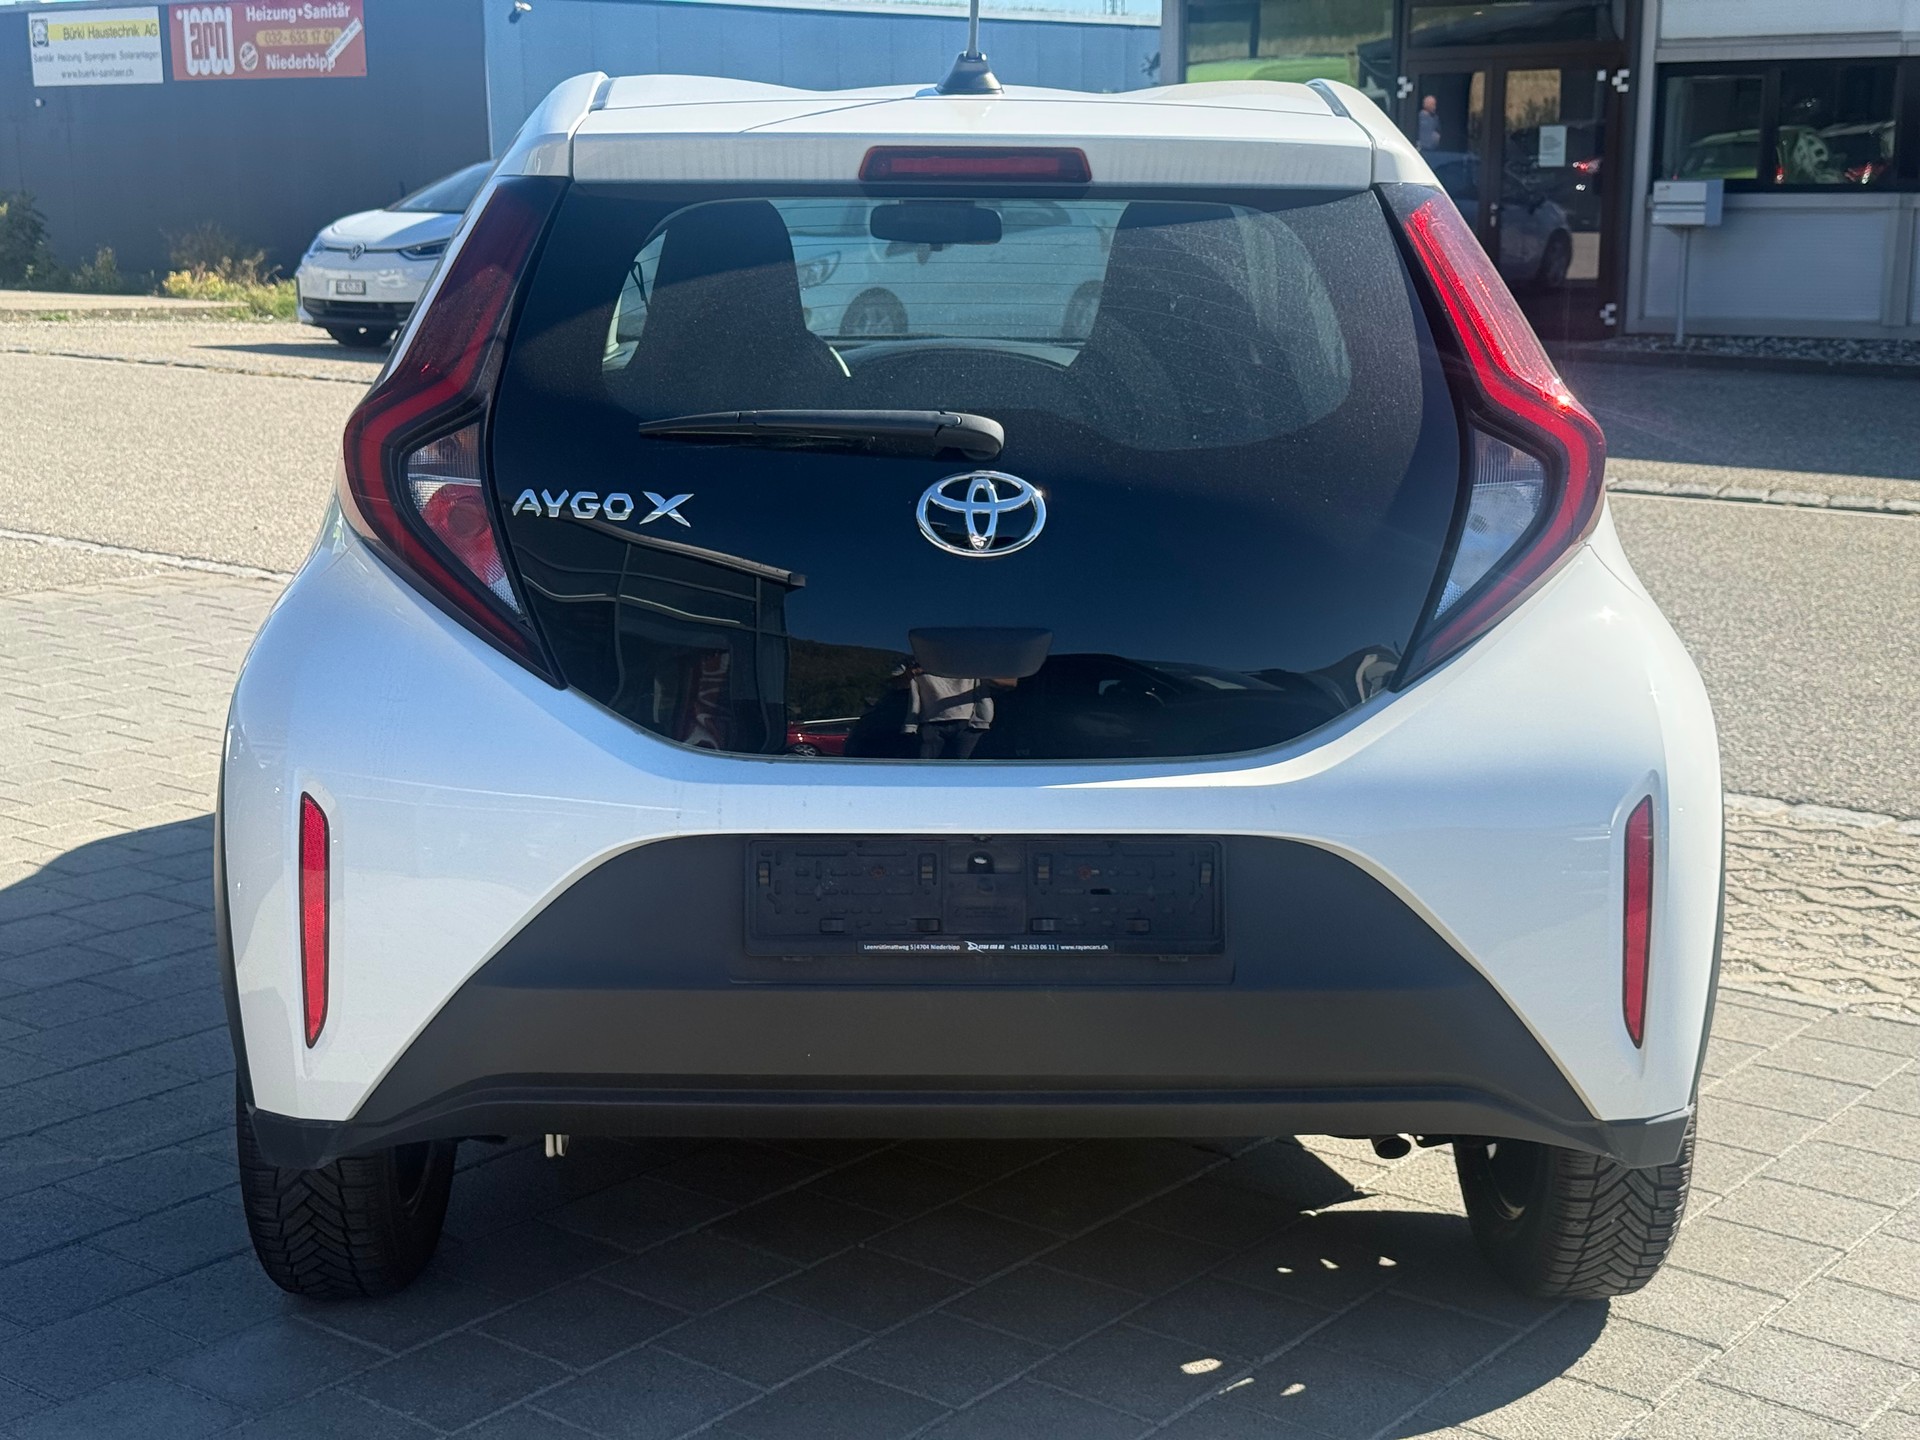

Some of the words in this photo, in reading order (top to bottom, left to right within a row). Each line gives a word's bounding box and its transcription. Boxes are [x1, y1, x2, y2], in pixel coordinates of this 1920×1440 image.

[63, 26, 85, 41] Bürki
[88, 24, 139, 39] Haustechnik
[144, 23, 158, 37] AG
[265, 53, 336, 72] Niederbipp
[512, 488, 634, 521] AYGO
[639, 490, 695, 528] X
